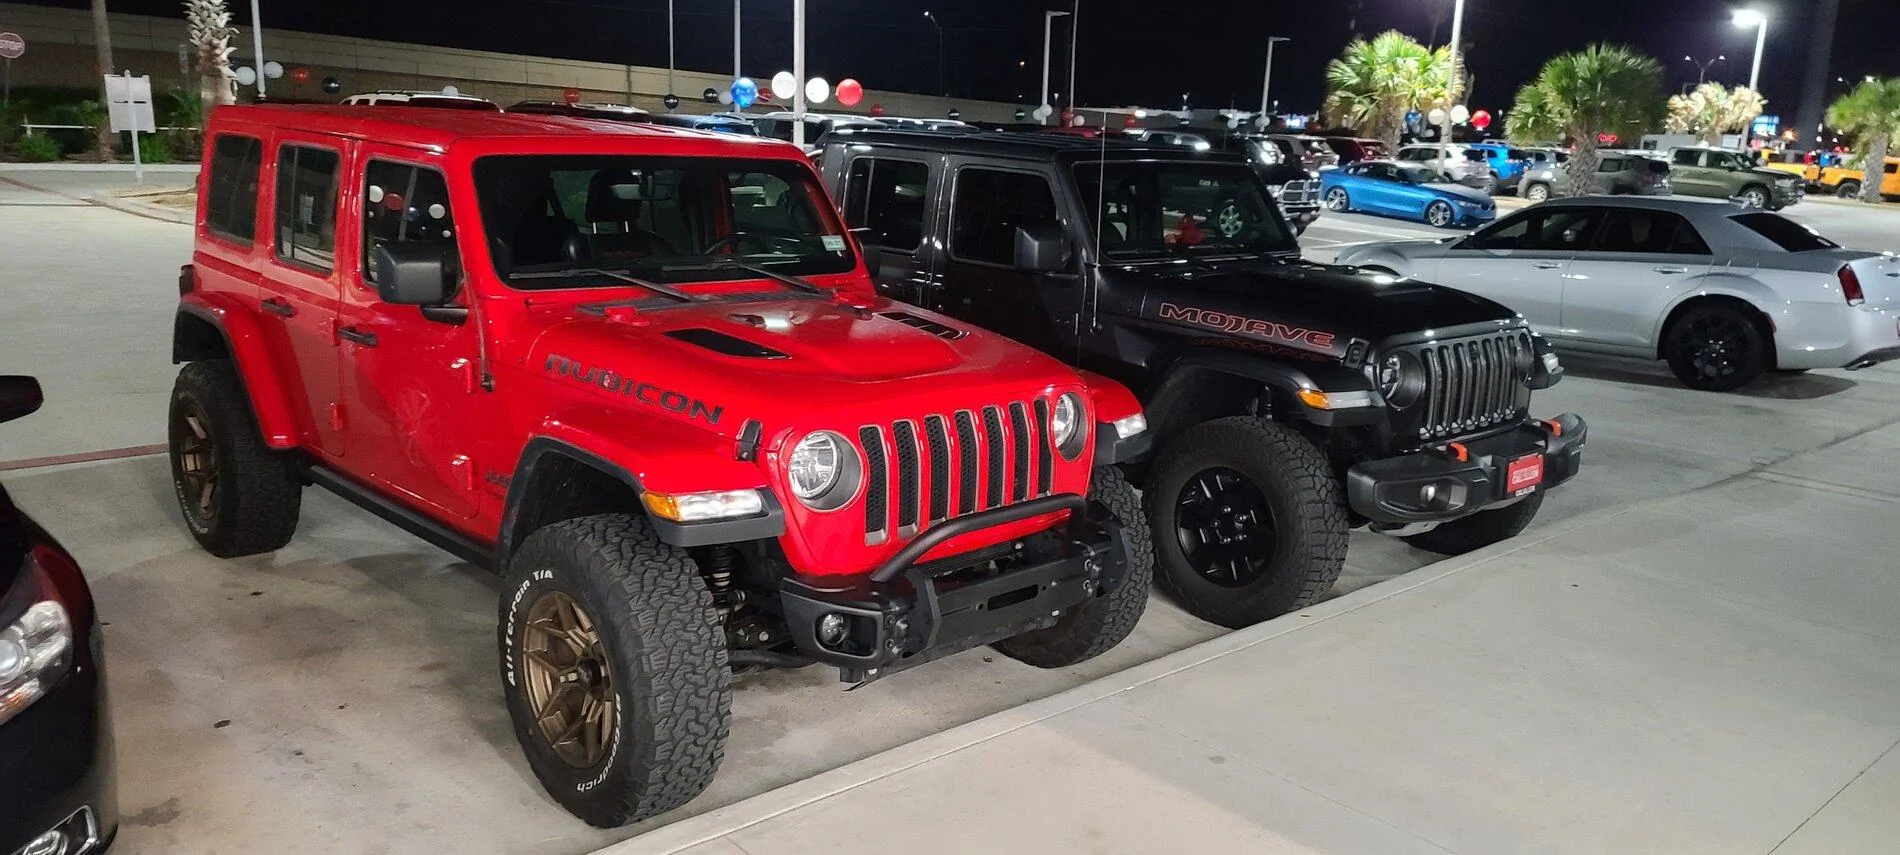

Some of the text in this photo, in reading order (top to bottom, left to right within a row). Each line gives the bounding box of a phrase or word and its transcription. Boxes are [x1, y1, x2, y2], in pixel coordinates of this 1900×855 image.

[1159, 302, 1336, 349] MOJAVE
[545, 353, 725, 425] RUBICON
[505, 569, 554, 687] All-Terrain T/A
